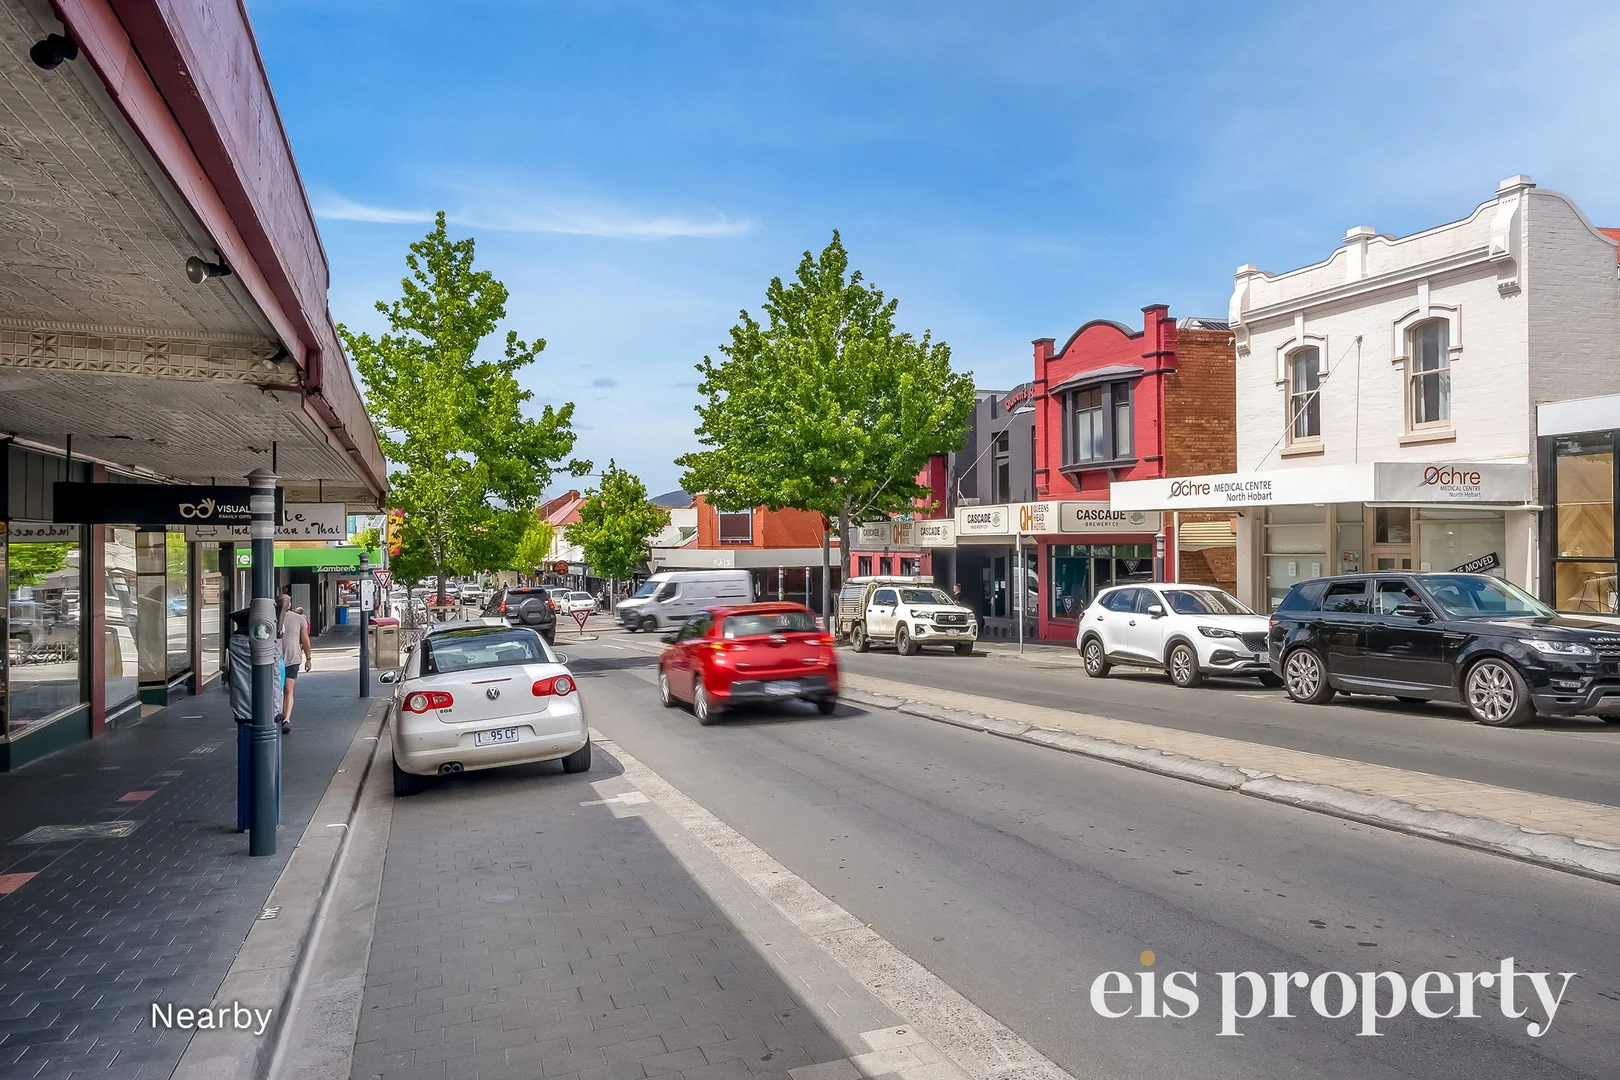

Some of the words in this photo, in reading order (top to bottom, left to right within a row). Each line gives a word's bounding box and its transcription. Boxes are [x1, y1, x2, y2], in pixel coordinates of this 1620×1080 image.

[1424, 465, 1481, 485] Ochre
[1169, 480, 1211, 497] Ochre
[1213, 482, 1244, 492] MEDICAL
[1244, 480, 1272, 491] CENTRE
[1226, 492, 1246, 502] North
[1247, 491, 1272, 501] Hobart
[216, 504, 251, 513] VISUAL
[1076, 509, 1126, 520] CASCADE
[967, 513, 991, 524] CASCADE
[304, 527, 311, 535] &
[310, 522, 340, 535] Thai
[920, 526, 941, 536] CASCADE
[1465, 555, 1494, 573] MOVED
[490, 730, 503, 741] 95
[504, 728, 516, 739] CF
